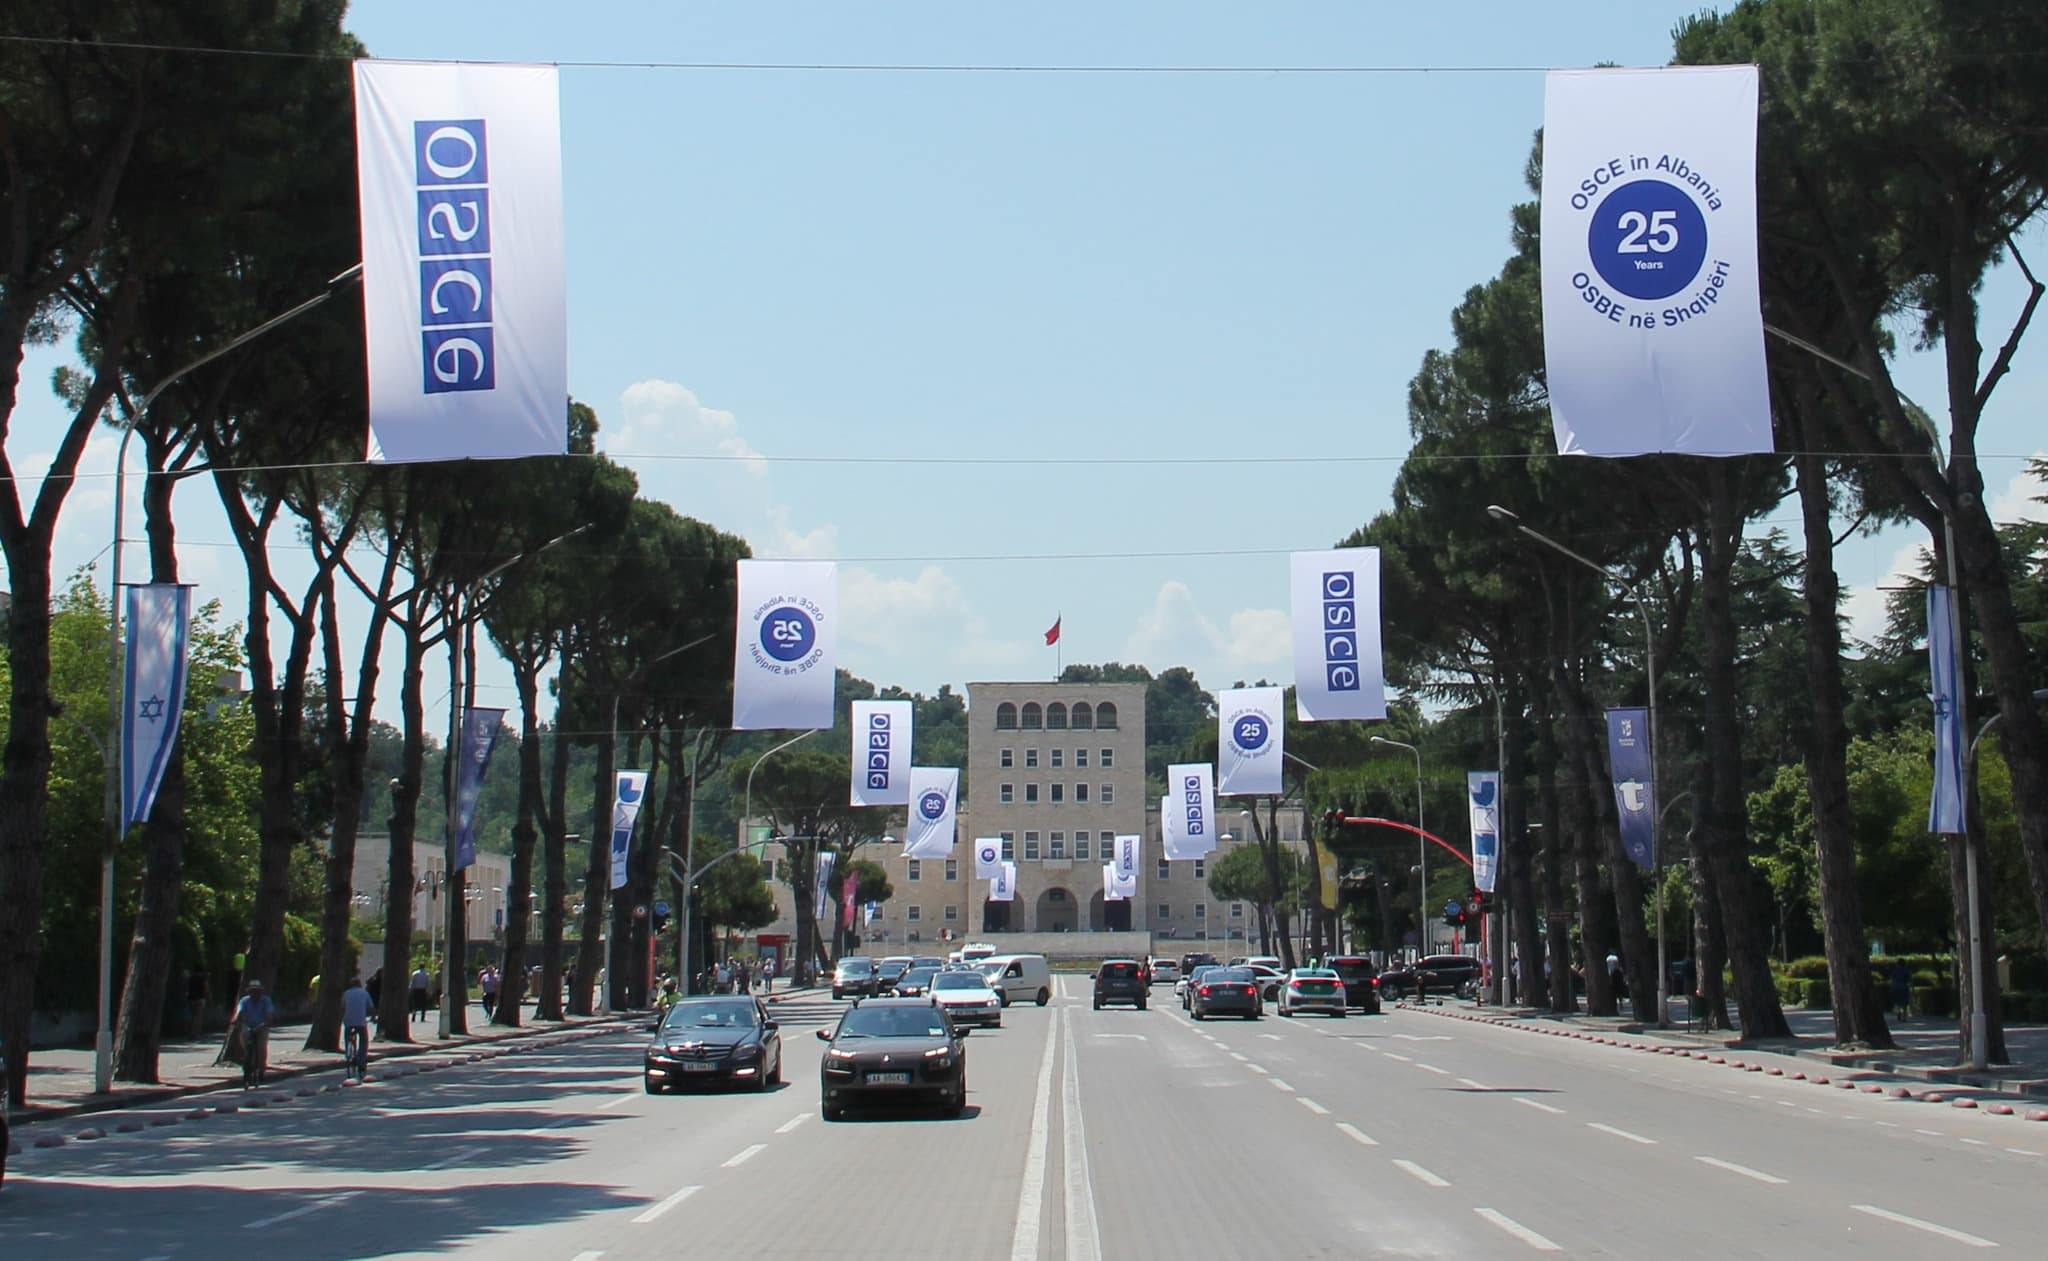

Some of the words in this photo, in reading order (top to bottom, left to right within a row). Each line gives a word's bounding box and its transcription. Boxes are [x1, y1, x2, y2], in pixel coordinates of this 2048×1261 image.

[1571, 158, 1625, 210] OSCE
[1630, 154, 1649, 171] in
[1656, 154, 1722, 212] Albania
[1617, 210, 1679, 254] 25
[1634, 260, 1663, 270] Years
[1572, 272, 1625, 323] OSBE
[1629, 312, 1656, 329] në
[1662, 260, 1730, 327] Shqipëri
[1241, 723, 1260, 737] 25
